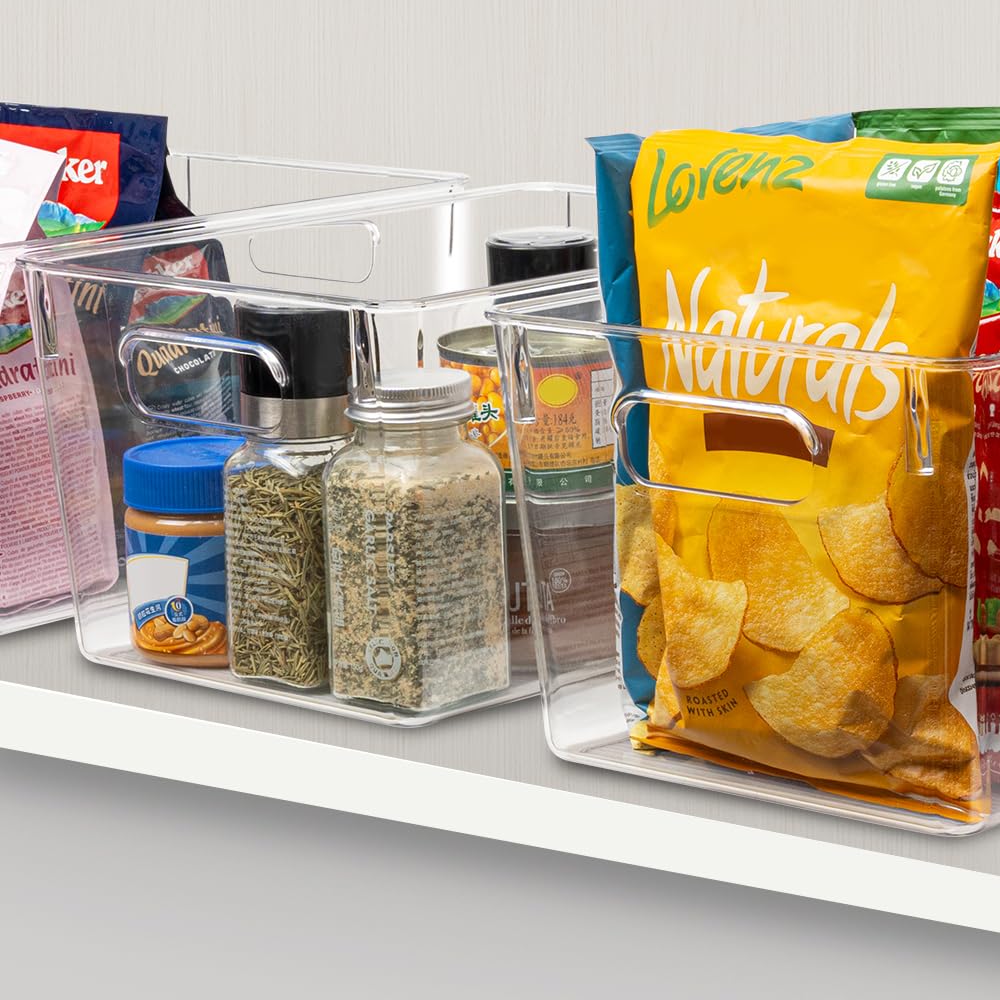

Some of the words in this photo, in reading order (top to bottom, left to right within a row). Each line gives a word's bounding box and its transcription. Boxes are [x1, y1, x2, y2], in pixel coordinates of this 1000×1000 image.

[647, 148, 816, 230] Lorenz
[662, 257, 910, 425] Naturals
[685, 688, 729, 705] ROASTED
[686, 705, 715, 717] WITH
[716, 697, 738, 716] SKIN
